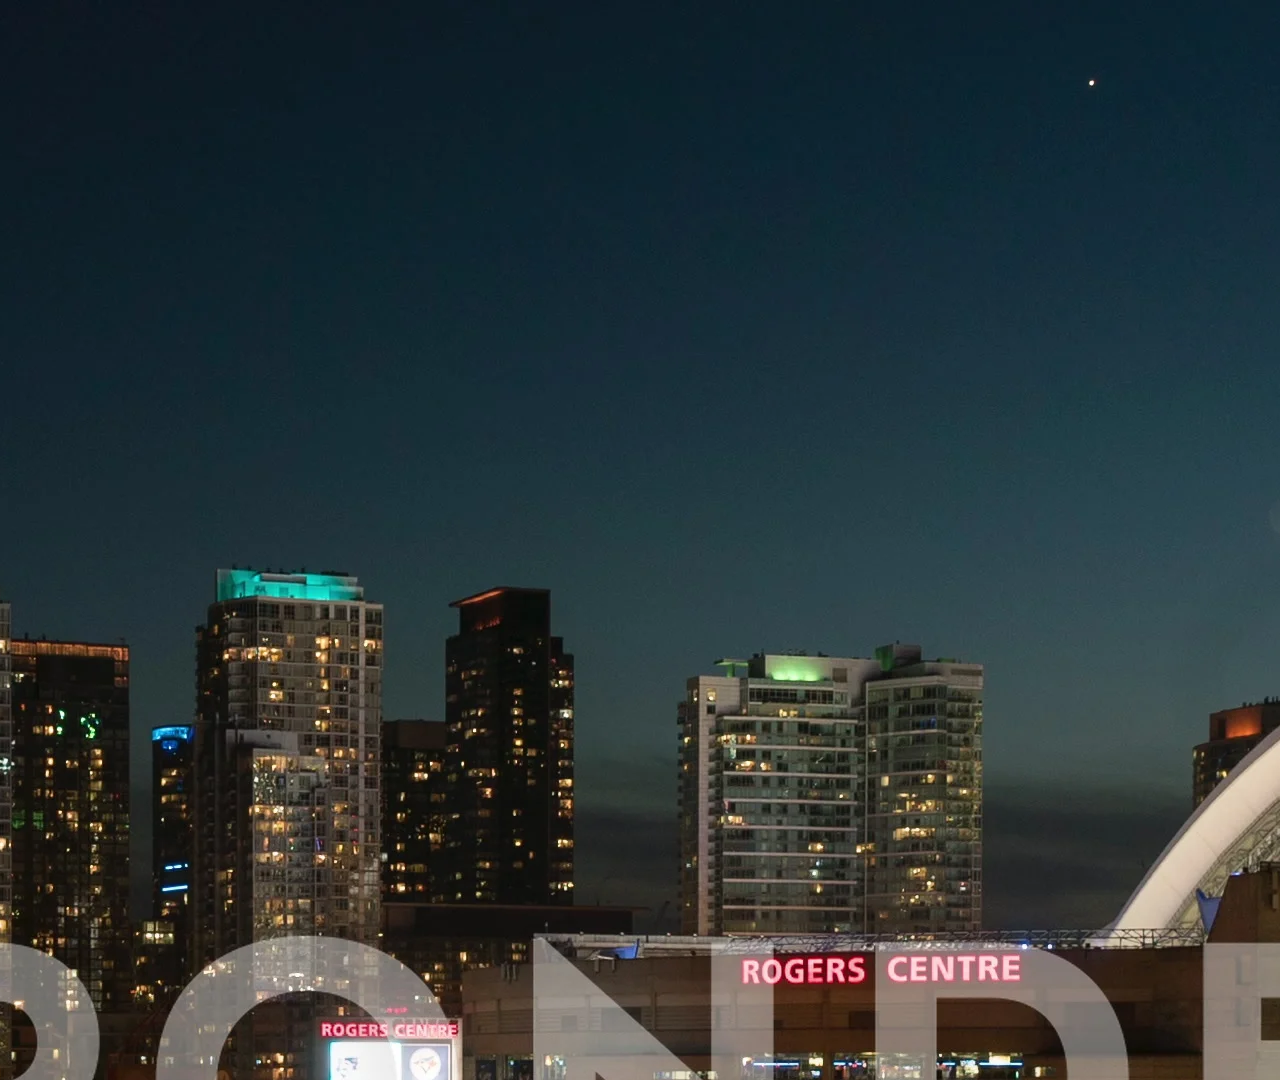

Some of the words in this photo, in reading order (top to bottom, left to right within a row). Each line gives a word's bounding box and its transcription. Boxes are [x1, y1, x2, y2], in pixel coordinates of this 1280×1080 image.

[742, 957, 865, 985] ROGERS
[886, 954, 1021, 983] CENTRE
[321, 1022, 389, 1038] ROGERS
[394, 1022, 460, 1039] CENTRE
